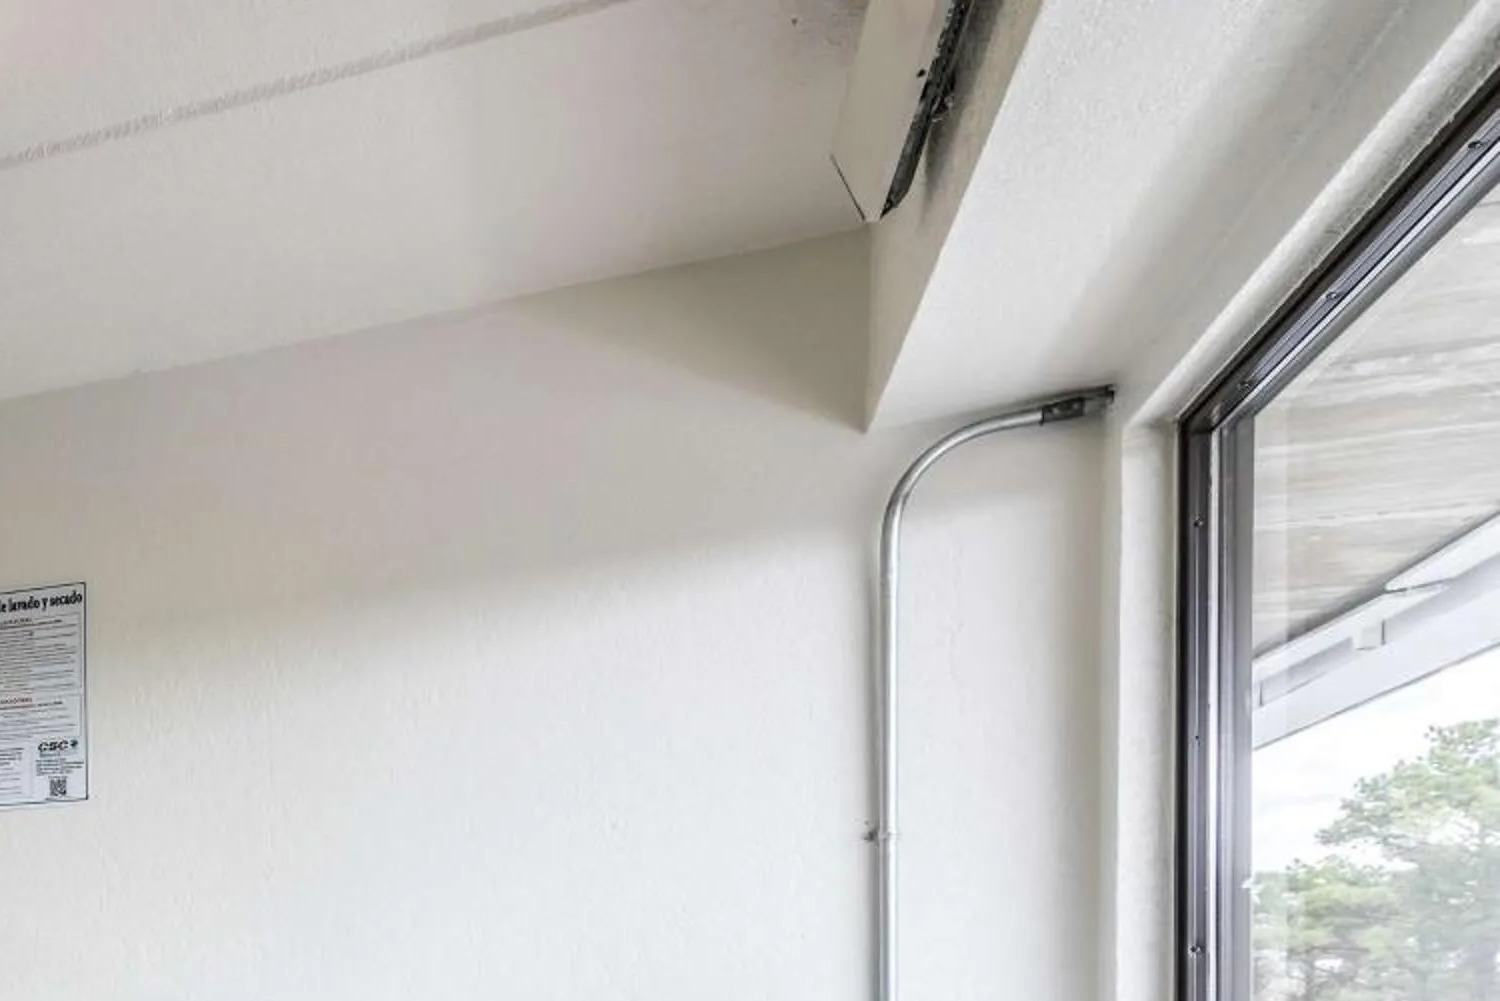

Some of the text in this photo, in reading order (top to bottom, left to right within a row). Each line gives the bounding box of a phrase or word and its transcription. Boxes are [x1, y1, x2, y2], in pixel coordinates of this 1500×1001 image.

[8, 596, 41, 612] lavado
[42, 597, 49, 612] y
[49, 590, 83, 606] secado
[38, 739, 69, 752] CSC
